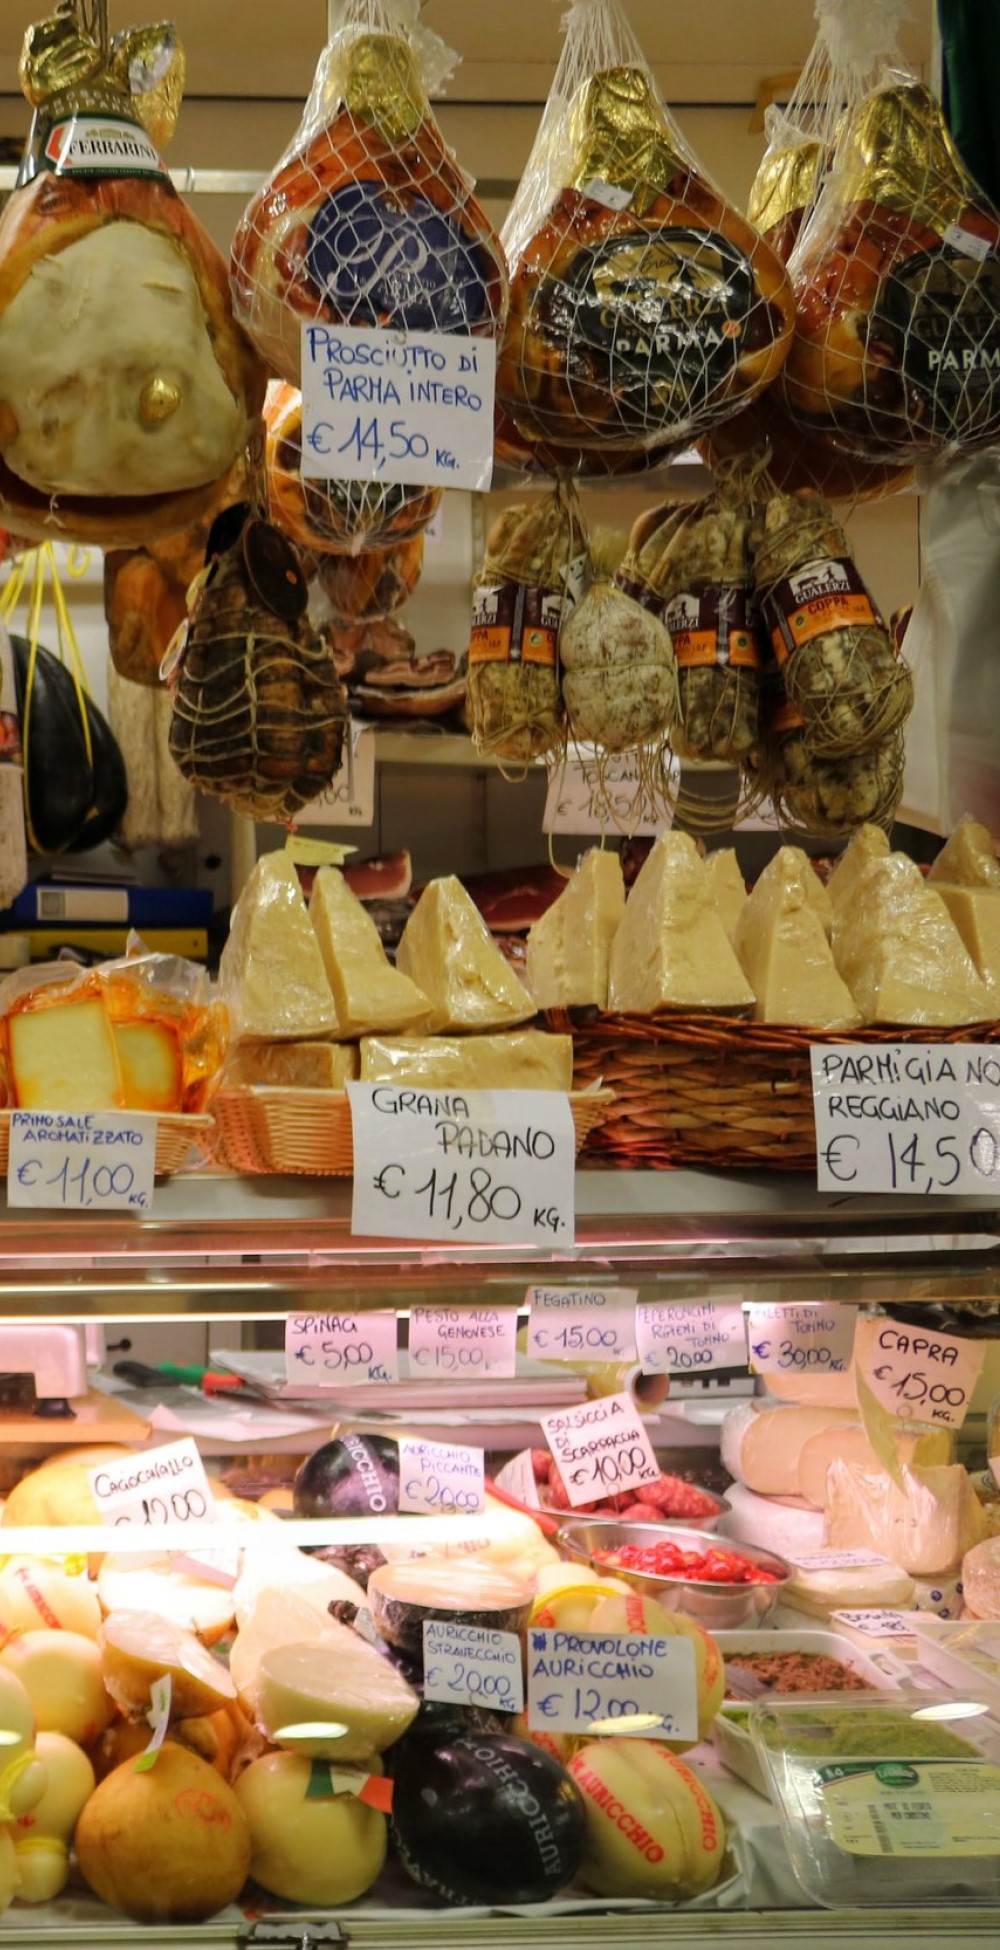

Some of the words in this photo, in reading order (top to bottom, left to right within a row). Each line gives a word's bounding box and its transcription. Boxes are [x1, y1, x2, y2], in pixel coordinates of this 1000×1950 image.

[69, 139, 157, 160] FERRARINI
[306, 326, 446, 371] PROSCIUTTO
[458, 345, 478, 373] DI
[616, 326, 721, 355] PARMA
[323, 367, 401, 406] PARMA
[407, 368, 482, 411] INTERO
[306, 422, 334, 454] €
[338, 416, 429, 470] 14,50
[795, 579, 851, 604] GUALERZI
[808, 596, 849, 615] COPPA
[372, 1087, 470, 1119] GRANA
[828, 1094, 961, 1123] REGGIANO
[55, 1114, 95, 1130] SALE
[435, 1120, 555, 1160] PADANO
[820, 1134, 861, 1182] €
[888, 1127, 999, 1195] 14,50
[17, 1159, 44, 1186] €
[46, 1156, 135, 1207] 11,00
[373, 1164, 405, 1199] €
[415, 1167, 521, 1230] 11,80
[533, 1207, 566, 1233] KG.
[533, 1289, 607, 1308] FEGATINO
[414, 1307, 461, 1325] PESTO
[468, 1309, 501, 1324] ALLA
[436, 1323, 507, 1340] GENOVESE
[532, 1330, 549, 1348] €
[553, 1325, 618, 1350] 15,00
[293, 1345, 316, 1367] €
[320, 1341, 374, 1370] 5,00
[412, 1347, 431, 1368] €
[433, 1345, 485, 1373] 15,00
[751, 1340, 772, 1360] €
[777, 1340, 832, 1371] 30,00
[878, 1330, 959, 1366] CAPRA
[873, 1365, 893, 1380] €
[890, 1372, 967, 1406] 15,00
[569, 1467, 590, 1486] €
[592, 1446, 647, 1486] 10,00
[425, 1623, 502, 1646] AURICCHIO
[552, 1631, 669, 1658] PROVOLONE
[425, 1667, 444, 1687] €
[446, 1662, 512, 1699] 20,00
[532, 1658, 654, 1680] AURICCHIO
[537, 1693, 564, 1718] €
[474, 1747, 563, 1877] AURICCHIO
[577, 1769, 665, 1864] AURICCHIO
